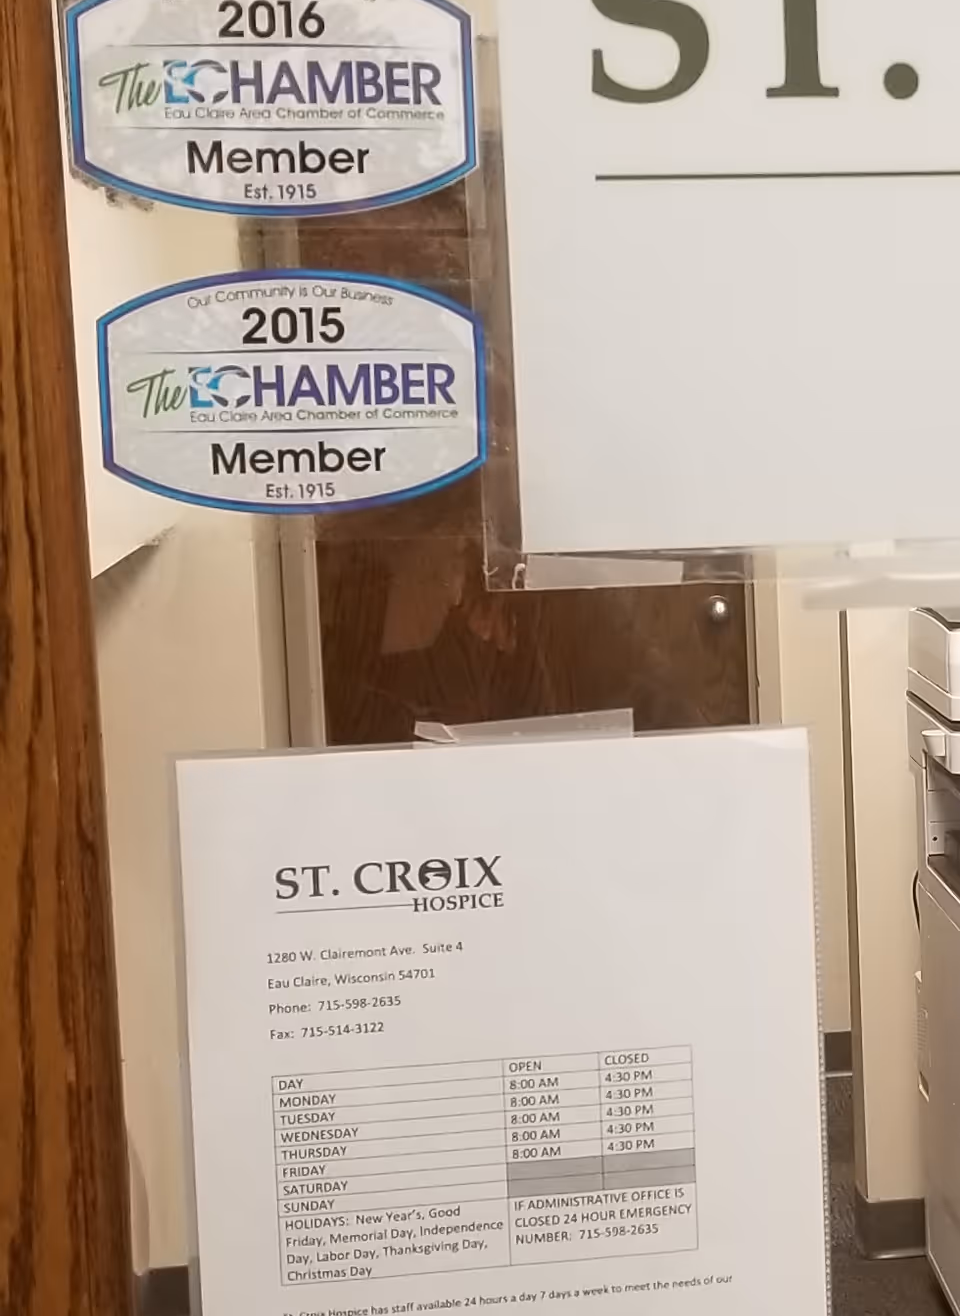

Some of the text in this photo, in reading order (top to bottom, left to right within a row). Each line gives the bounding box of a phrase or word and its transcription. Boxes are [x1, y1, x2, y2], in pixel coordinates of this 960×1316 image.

[217, 0, 324, 38] 2016
[98, 61, 160, 114] The
[164, 107, 444, 120] Eau Claire Area Chamber of Commerce
[187, 140, 370, 174] Member
[244, 184, 316, 199] Est. 1915
[187, 285, 394, 309] Our Community is Our Business
[242, 307, 345, 345] 2015
[126, 368, 188, 419] The
[190, 409, 458, 423] Eau Claire Area Chamber of Commerce
[211, 442, 386, 475] Member
[266, 483, 335, 498] Est. 1915
[274, 855, 503, 900] ST. CROIX
[412, 892, 504, 912] HOSPICE
[267, 941, 463, 964] 1280 W. Clairemont Ave. Suite 4
[268, 968, 435, 989] Eau Claire, Wisconsin 54701
[269, 995, 401, 1015] Phone: 715-598-2635
[270, 1022, 384, 1040] Fax: 715-514-3122
[604, 1052, 649, 1065] CLOSED
[509, 1060, 542, 1073] OPEN
[604, 1069, 652, 1083] 4:30 PM
[278, 1078, 303, 1091] DAY
[509, 1077, 559, 1091] 8:00 AM
[279, 1094, 336, 1107] MONDAY
[605, 1086, 653, 1100] 4:30 PM
[510, 1094, 560, 1108] 8:00 AM
[606, 1103, 654, 1117] 4:30 PM
[280, 1112, 335, 1126] TUESDAY
[511, 1111, 560, 1125] 8:00 AM
[606, 1120, 654, 1134] 4:30 PM
[281, 1127, 359, 1144] WEDNESDAY
[511, 1128, 561, 1142] 8:00 AM
[512, 1145, 561, 1159] 8:00 AM
[607, 1137, 655, 1152] 4:30 PM
[281, 1146, 347, 1161] THURSDAY
[283, 1164, 326, 1178] FRIDAY
[283, 1181, 348, 1196] SATURDAY
[283, 1200, 335, 1213] SUNDAY
[514, 1187, 685, 1211] IF ADMINISTRATIVE OFFICE IS
[285, 1205, 461, 1231] HOLIDAYS: New Year's, Good
[515, 1203, 692, 1228] CLOSED 24 HOUR EMERGENCY
[286, 1218, 503, 1250] Friday, Memorial Day, Independence
[515, 1223, 659, 1245] NUMBER: 715-598-2635
[286, 1237, 488, 1266] Day, Labor Day, Thanksgiving Day,
[287, 1264, 372, 1281] Christmas Day
[371, 1306, 388, 1315] has
[392, 1303, 414, 1314] staff
[416, 1299, 461, 1311] available
[464, 1298, 476, 1306] 24
[479, 1295, 508, 1305] hours
[519, 1292, 537, 1303] day
[541, 1291, 546, 1299] 7
[549, 1290, 572, 1301] days
[583, 1286, 609, 1296] week
[625, 1283, 650, 1292] meet
[653, 1280, 670, 1290] the
[672, 1278, 701, 1288] needs
[704, 1275, 714, 1284] of
[716, 1275, 733, 1283] our
